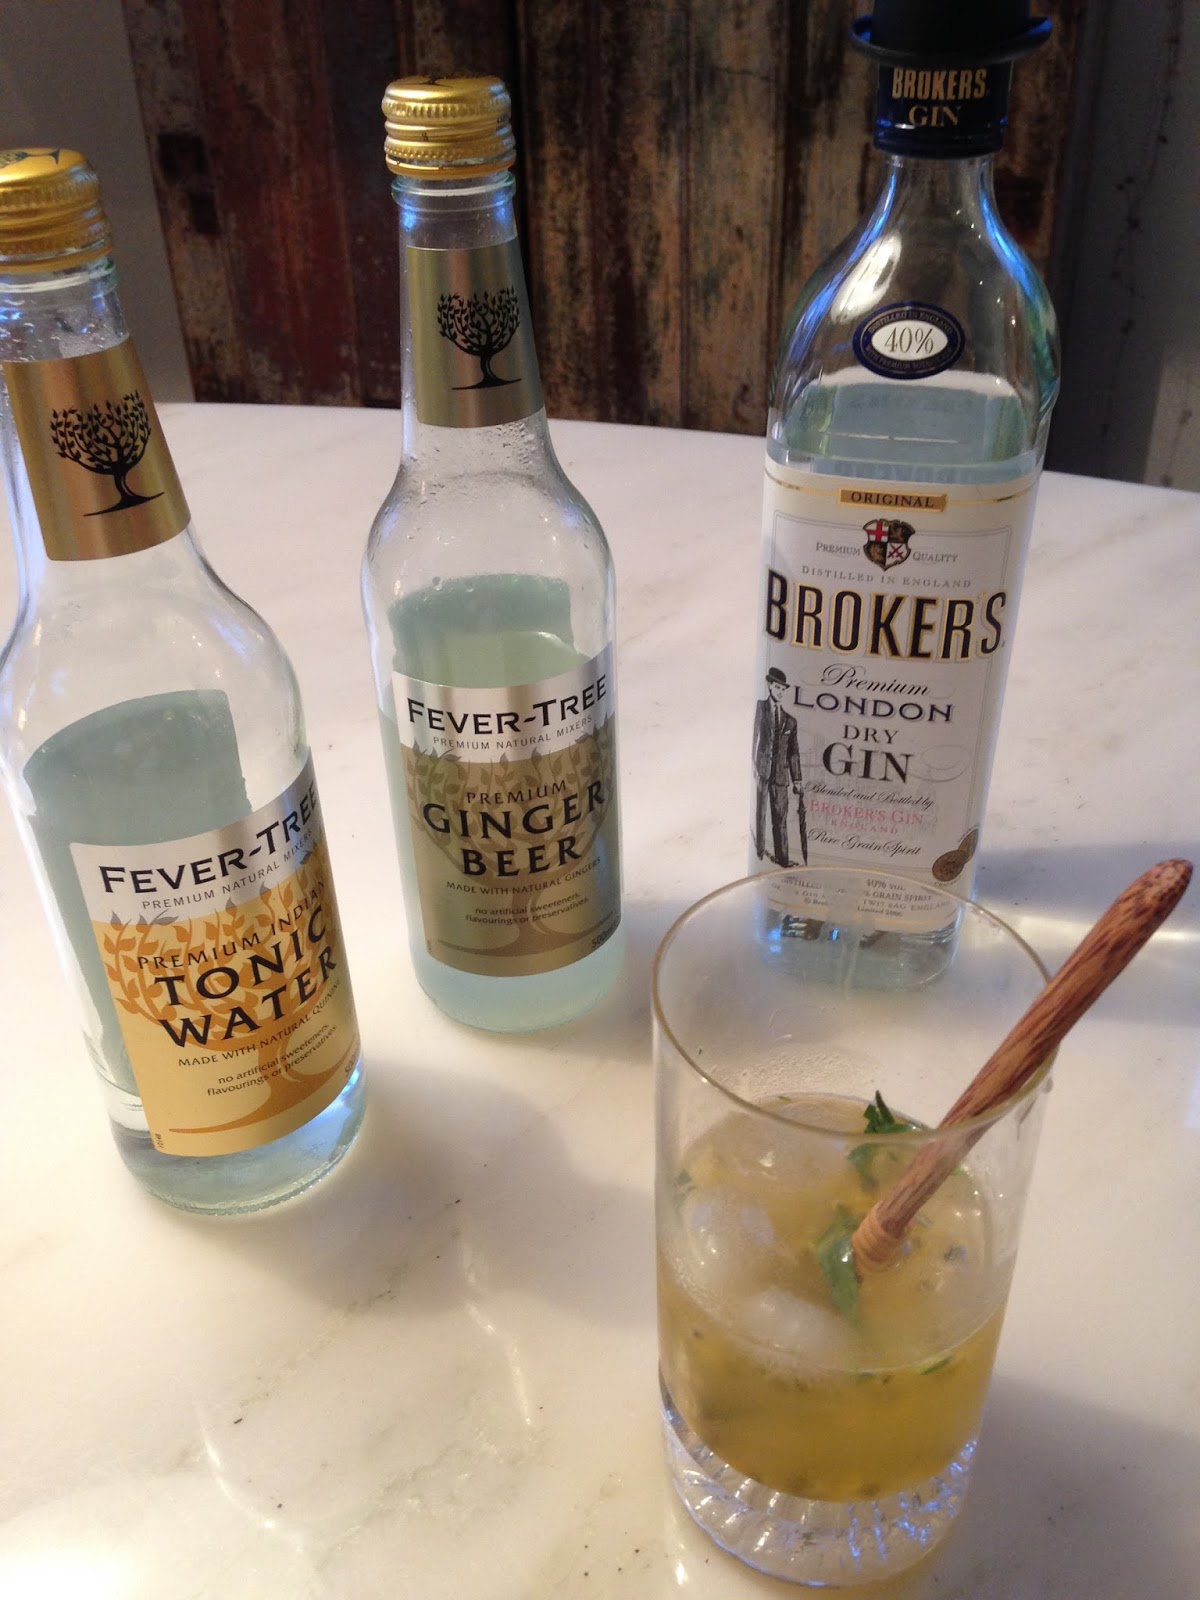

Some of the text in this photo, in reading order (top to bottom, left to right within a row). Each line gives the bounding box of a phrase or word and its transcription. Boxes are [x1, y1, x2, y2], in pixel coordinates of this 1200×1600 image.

[908, 105, 962, 127] GIN
[885, 326, 934, 354] 40%
[851, 491, 934, 508] ORIGINAL
[816, 541, 959, 563] PREMIUM QUALITY
[801, 565, 972, 589] DISTILLED IN ENGLAND
[820, 663, 930, 697] Premium
[407, 674, 607, 735] FEVER-TREE
[793, 685, 954, 722] LONDON
[433, 714, 593, 750] PREMIUM NATURAL MIXERS
[843, 724, 899, 745] DRY
[822, 742, 914, 785] GIN
[466, 779, 567, 805] PREMIUM
[804, 780, 935, 811] Blended and Bottled by
[423, 780, 606, 839] GINGER
[890, 809, 924, 825] GIN
[98, 780, 318, 894] FEVER-TREE
[807, 828, 921, 858] Pure Grain Spirit
[142, 829, 312, 910] PREMIUM NATURAL MIXERS
[459, 835, 583, 877] BEER
[446, 856, 602, 896] MADE WITH NATURAL GINGERS
[137, 880, 326, 970] PREMIUM INDIAN
[465, 914, 518, 927] flavourings
[518, 916, 530, 924] or
[475, 907, 488, 915] no
[490, 906, 528, 916] artificial
[154, 905, 327, 1007] TONIC
[157, 945, 337, 1048] WATER
[178, 1054, 219, 1067] MADE
[221, 1043, 257, 1061] WITH
[260, 1014, 312, 1049] NATURAL
[207, 1074, 270, 1097] flavourings
[271, 1066, 284, 1078] or
[218, 1075, 234, 1085] no
[236, 1057, 280, 1081] artificial
